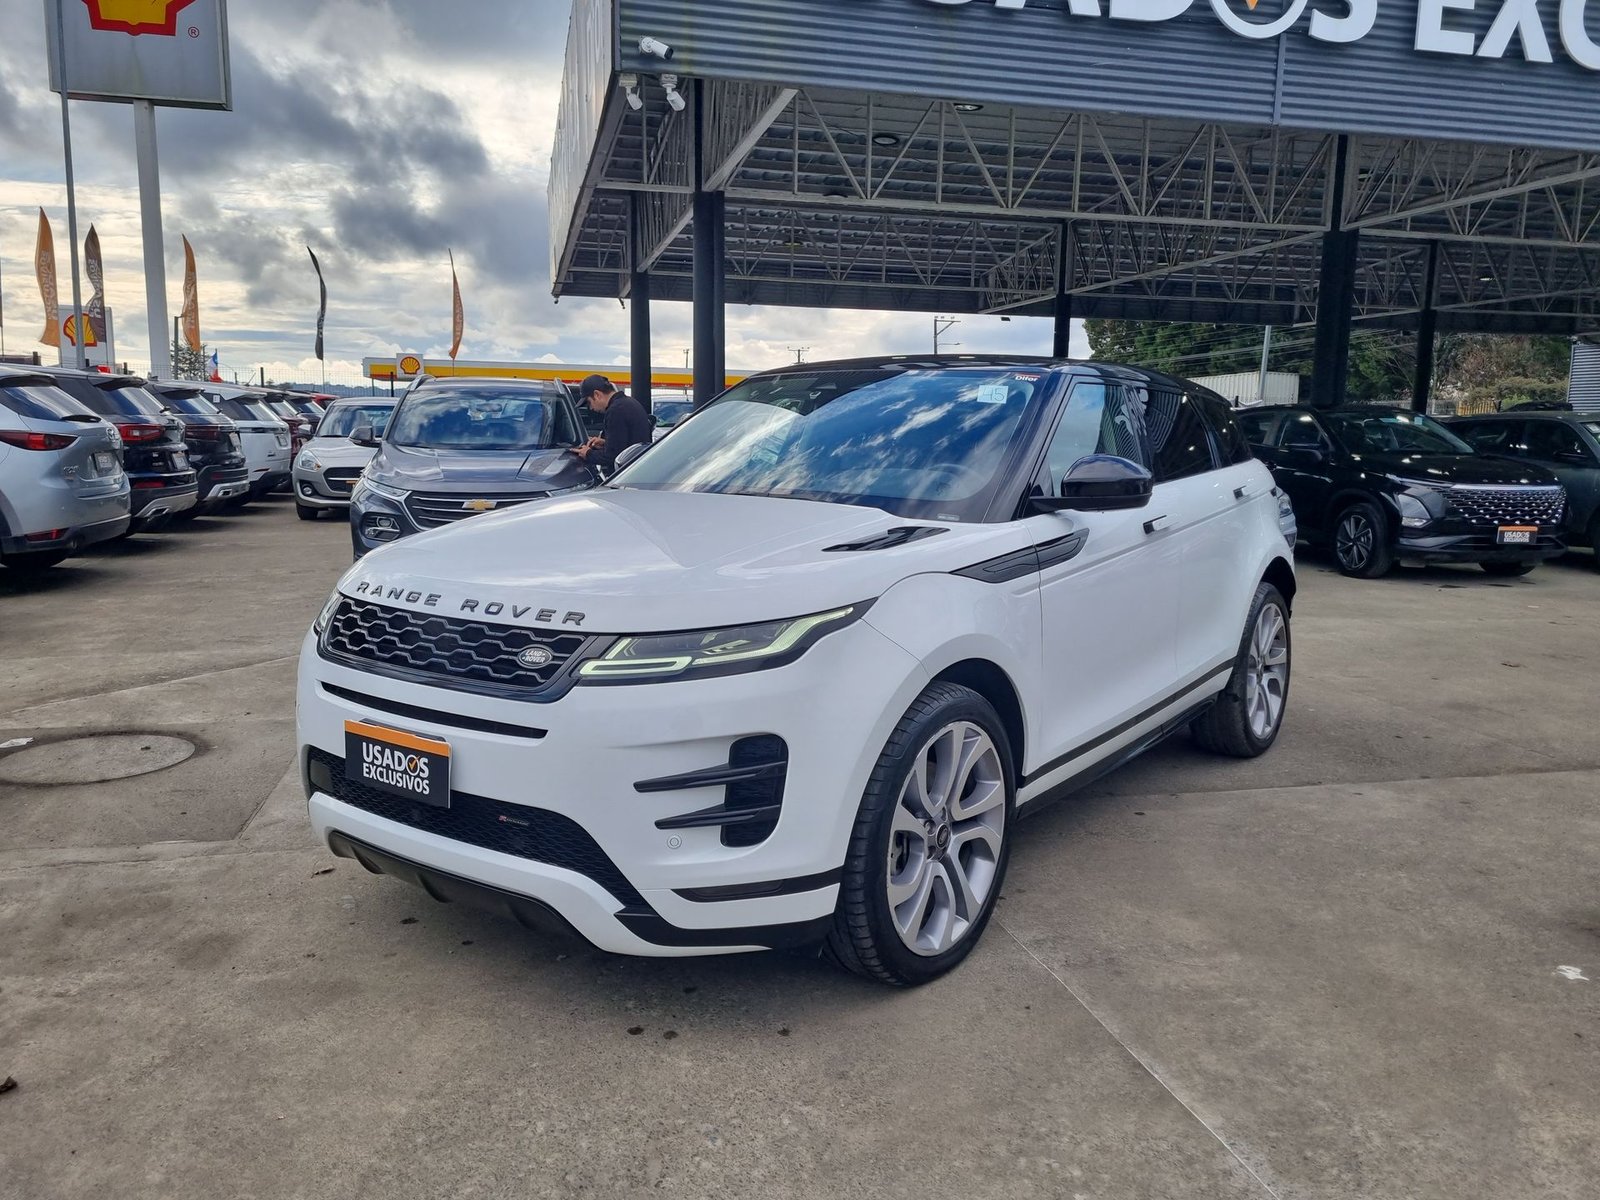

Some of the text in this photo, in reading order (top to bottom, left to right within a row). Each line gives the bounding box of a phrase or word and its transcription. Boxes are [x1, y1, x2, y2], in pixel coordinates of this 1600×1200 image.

[356, 581, 587, 626] RANGE ROVER
[362, 742, 430, 778] USADOS
[362, 762, 430, 795] EXCLUSIVOS
